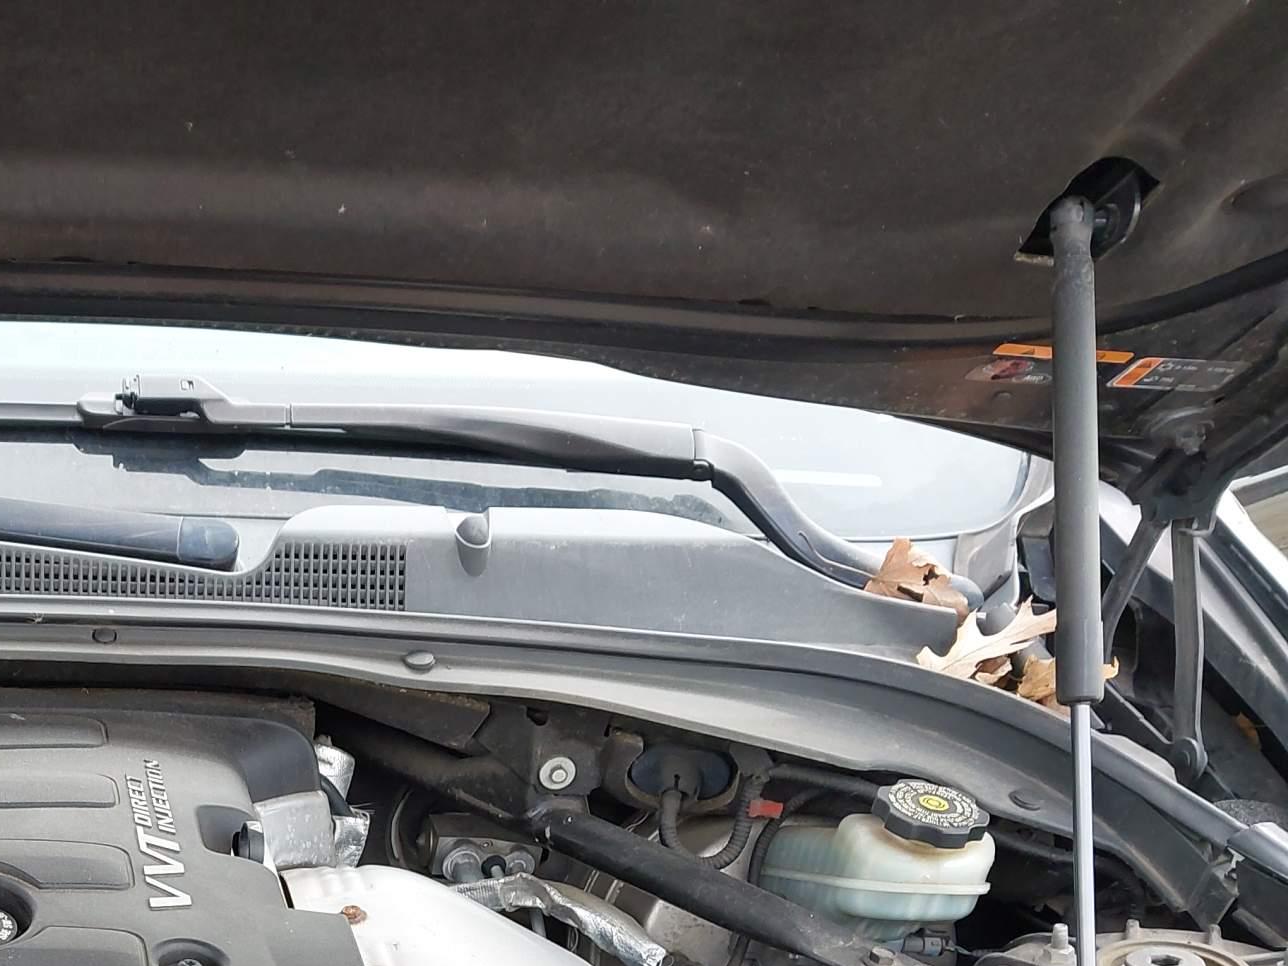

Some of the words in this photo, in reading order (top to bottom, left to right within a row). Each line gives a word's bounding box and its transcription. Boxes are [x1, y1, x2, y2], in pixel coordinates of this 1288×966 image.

[126, 774, 153, 828] DIRECT
[144, 759, 176, 835] INJECTION
[136, 826, 193, 909] VVT
